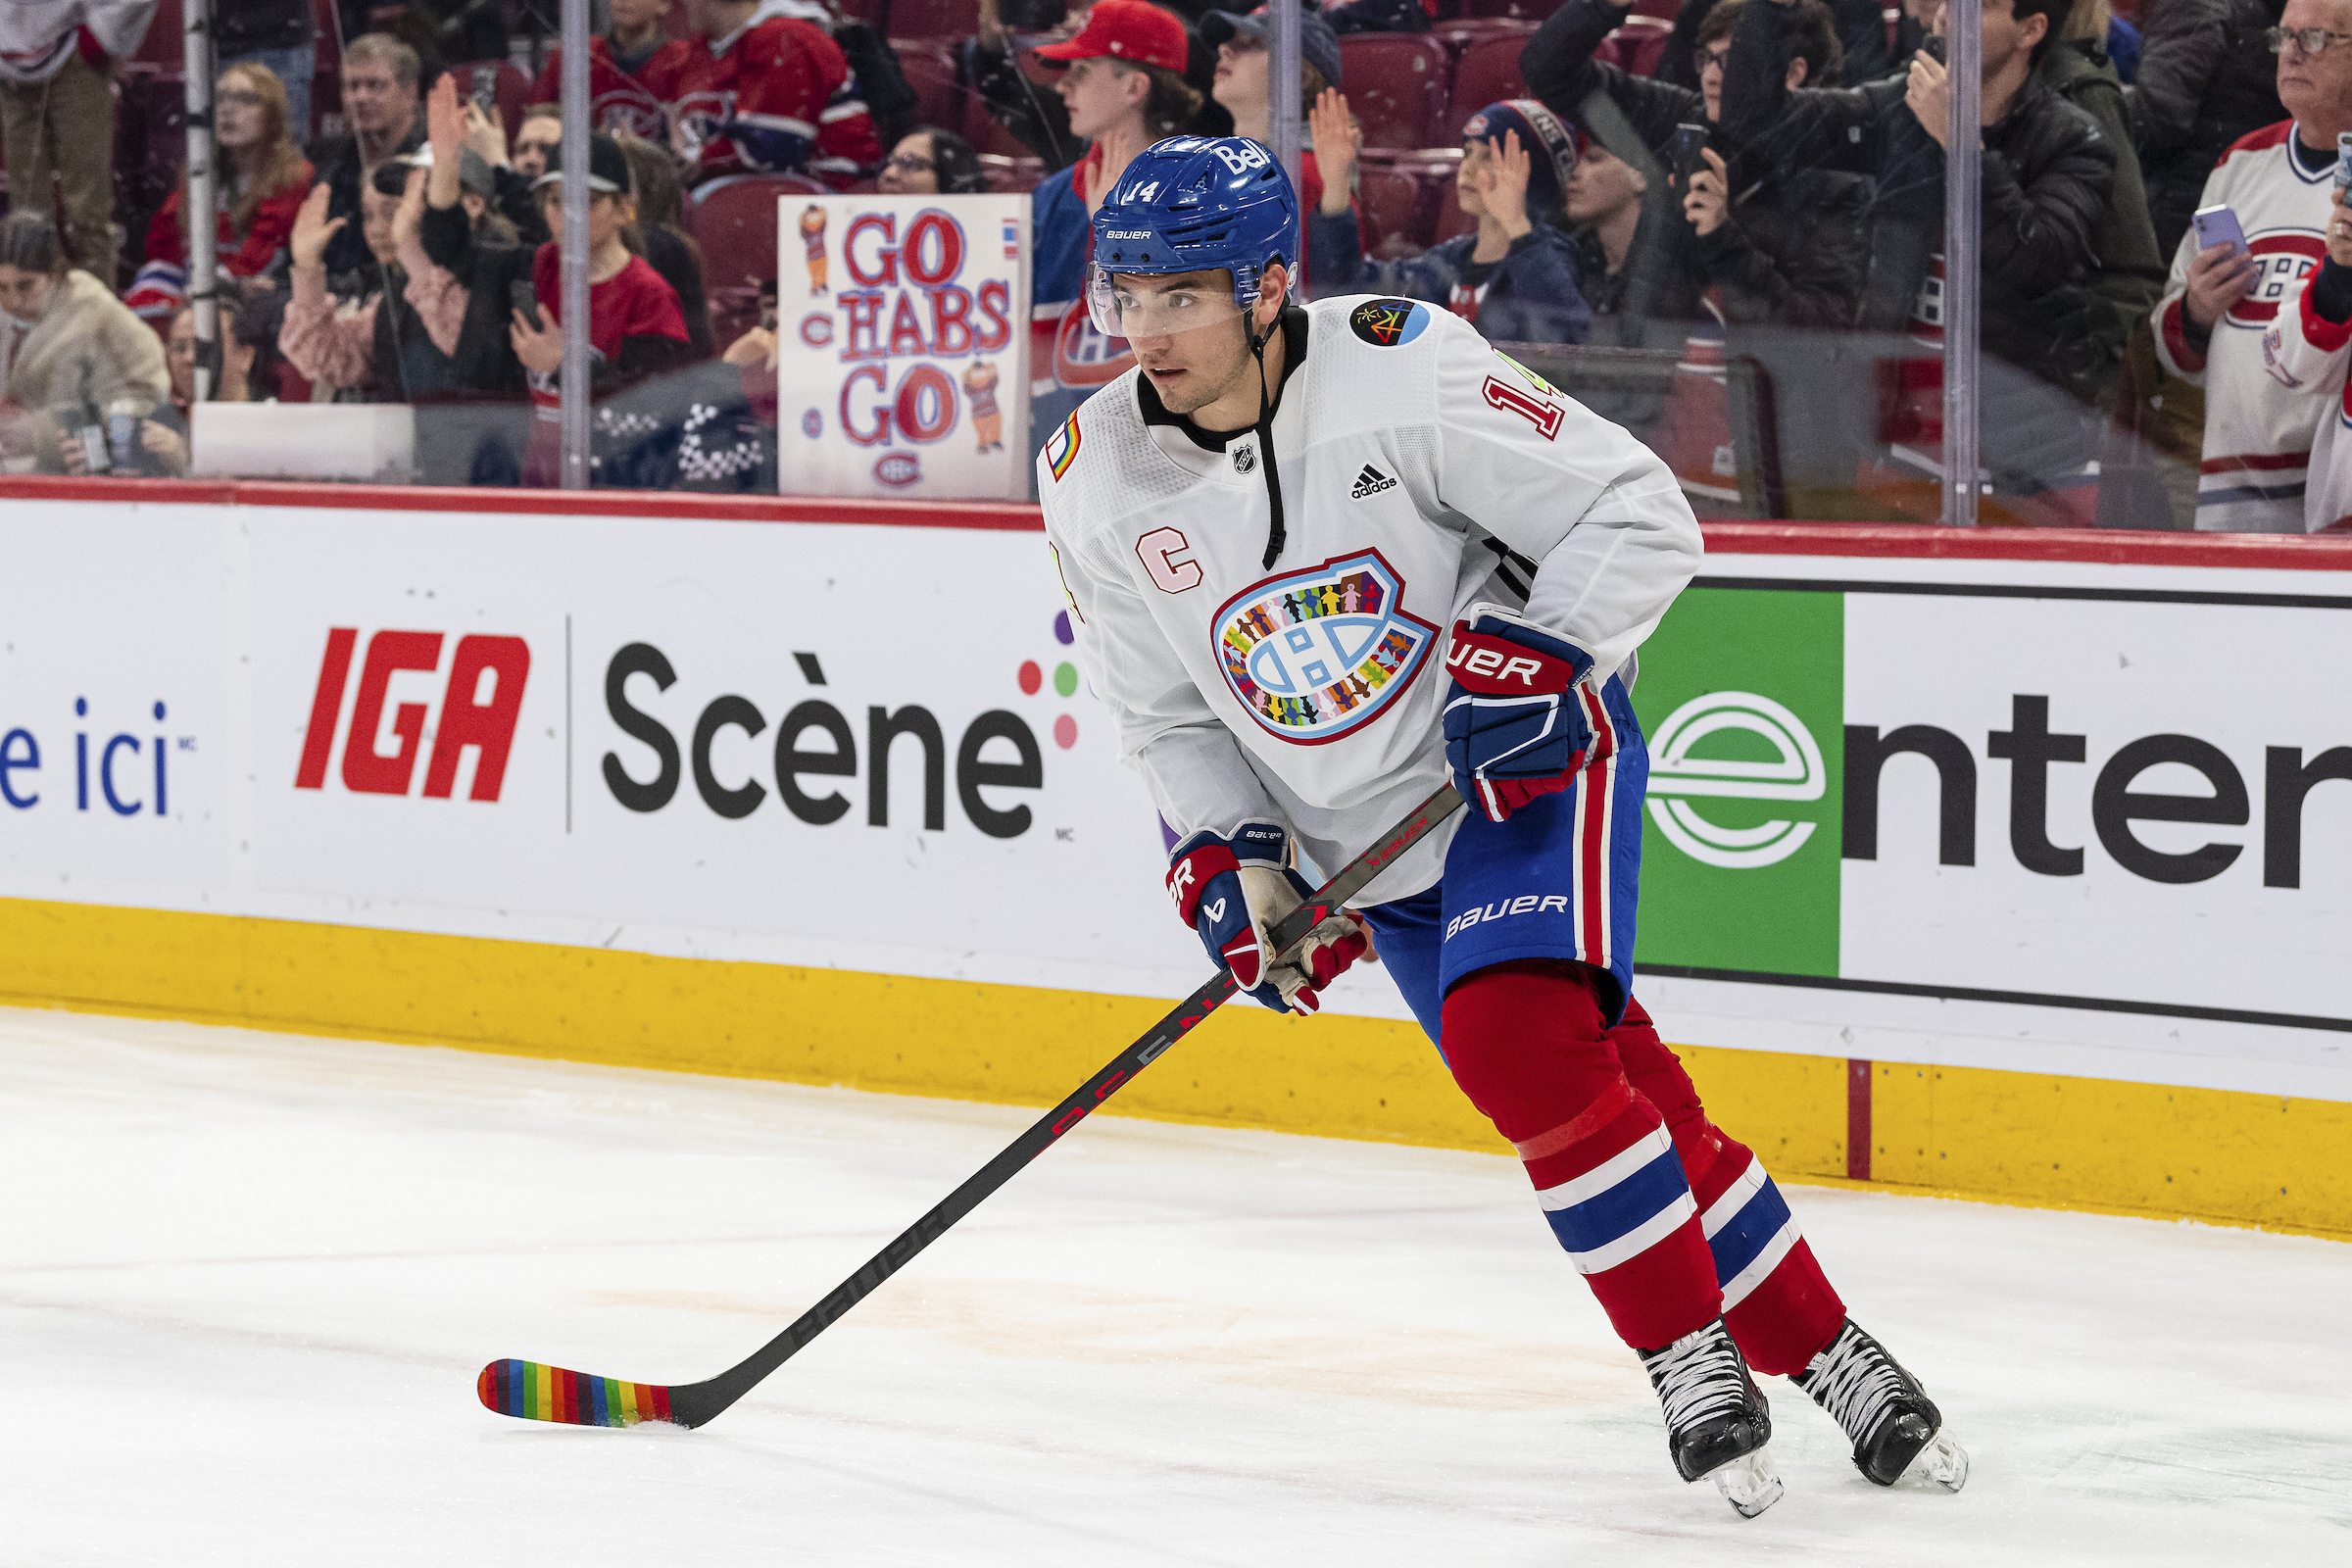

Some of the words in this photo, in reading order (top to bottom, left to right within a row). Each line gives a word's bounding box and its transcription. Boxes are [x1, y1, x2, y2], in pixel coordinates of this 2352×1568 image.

[1214, 137, 1271, 174] Bell
[1127, 180, 1160, 203] 14
[843, 207, 967, 288] GO
[836, 278, 1011, 363] HABS
[838, 362, 960, 448] GO
[1350, 477, 1397, 500] adidas
[1135, 526, 1204, 595] C
[1446, 638, 1543, 686] UER
[295, 627, 531, 803] IGA
[602, 642, 1043, 840] Scène
[75, 697, 167, 816] ici
[1380, 816, 1429, 860] BAUER
[1444, 895, 1569, 944] BAUER
